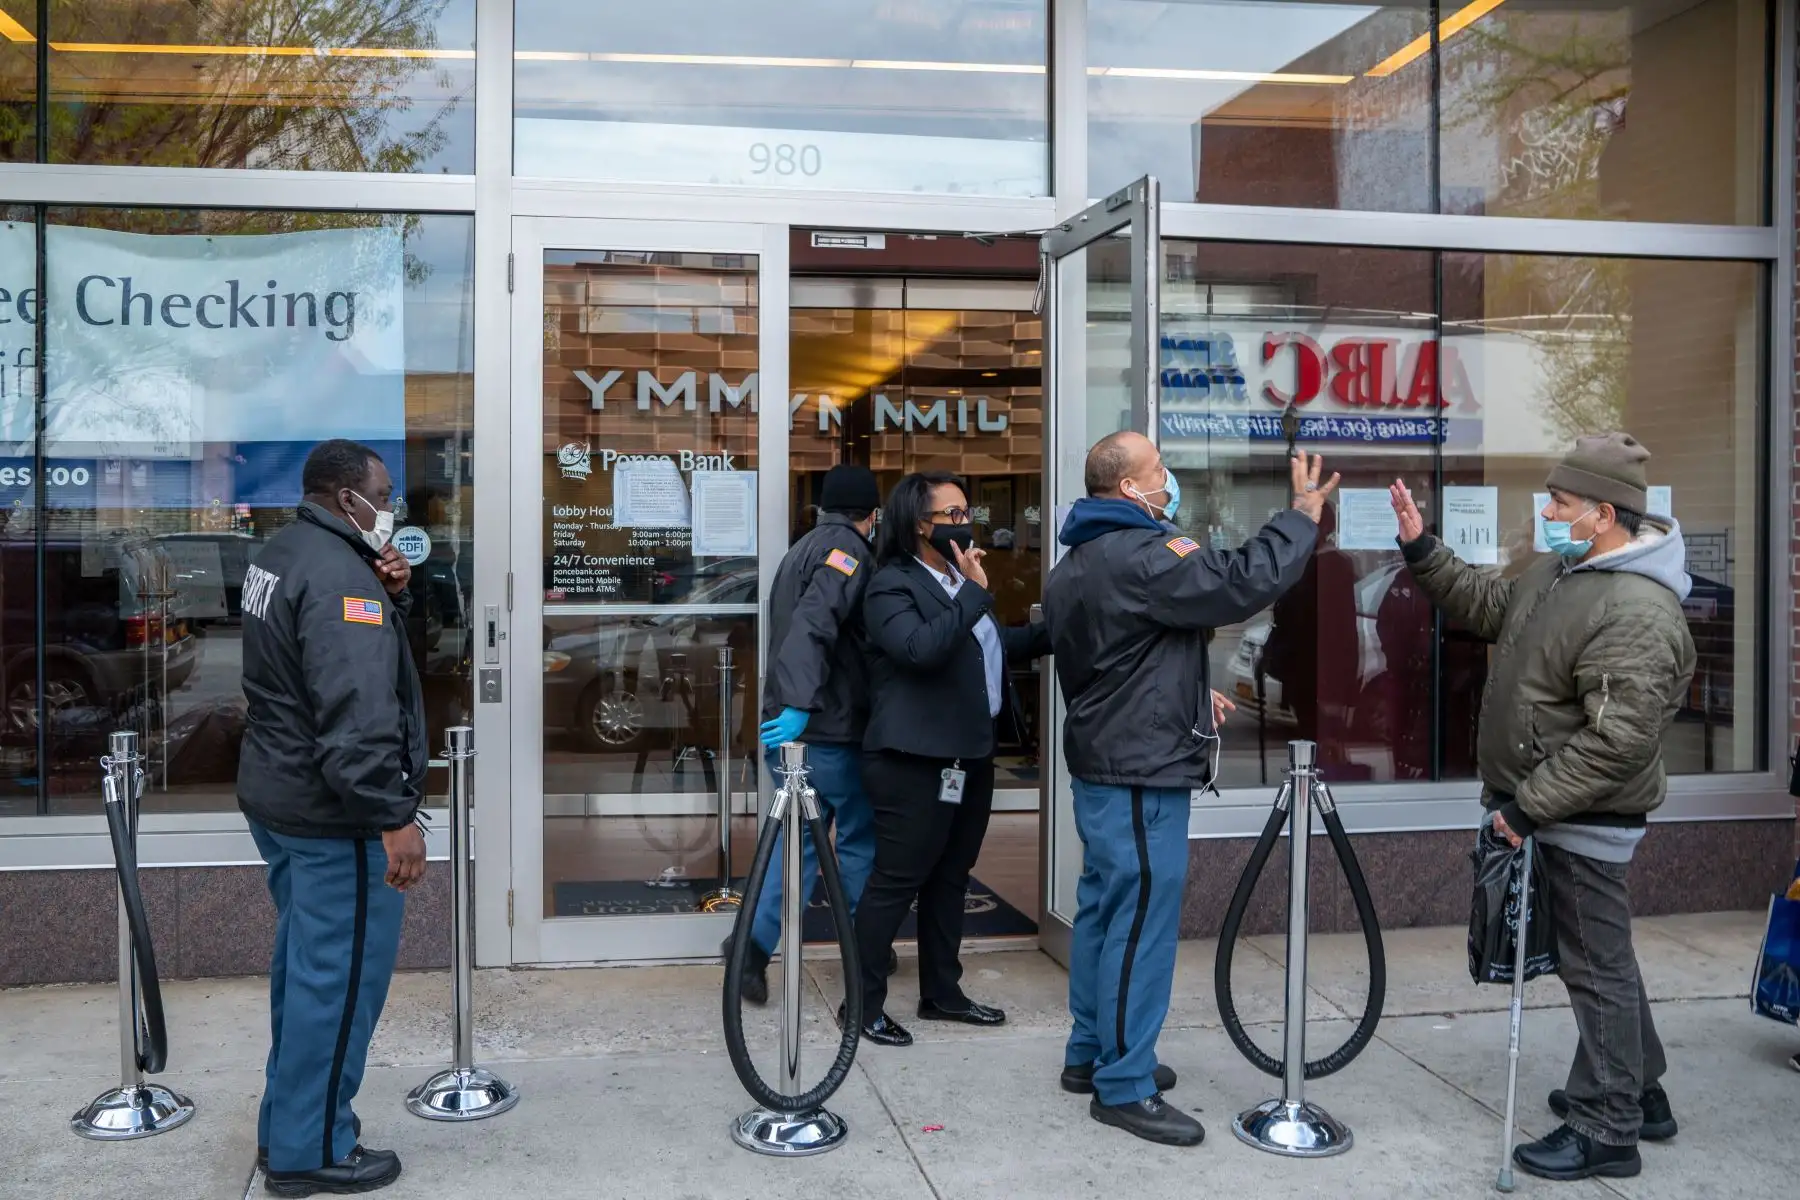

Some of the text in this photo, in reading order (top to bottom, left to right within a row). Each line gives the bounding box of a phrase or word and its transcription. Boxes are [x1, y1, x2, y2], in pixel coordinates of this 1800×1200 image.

[749, 142, 822, 176] 980
[75, 274, 360, 341] Checking
[678, 449, 737, 471] Bank
[553, 505, 587, 519] Lobby
[553, 522, 584, 531] Monday
[553, 531, 576, 540] Friday
[398, 542, 424, 552] CDFI
[553, 539, 586, 548] Saturday
[628, 539, 660, 547] 10:00am
[553, 554, 655, 567] 24/7 Convenience
[553, 568, 610, 577] poncebank.com
[576, 576, 595, 584] Bank
[596, 576, 622, 584] Mobile
[553, 585, 616, 593] Ponce Bank ATMs
